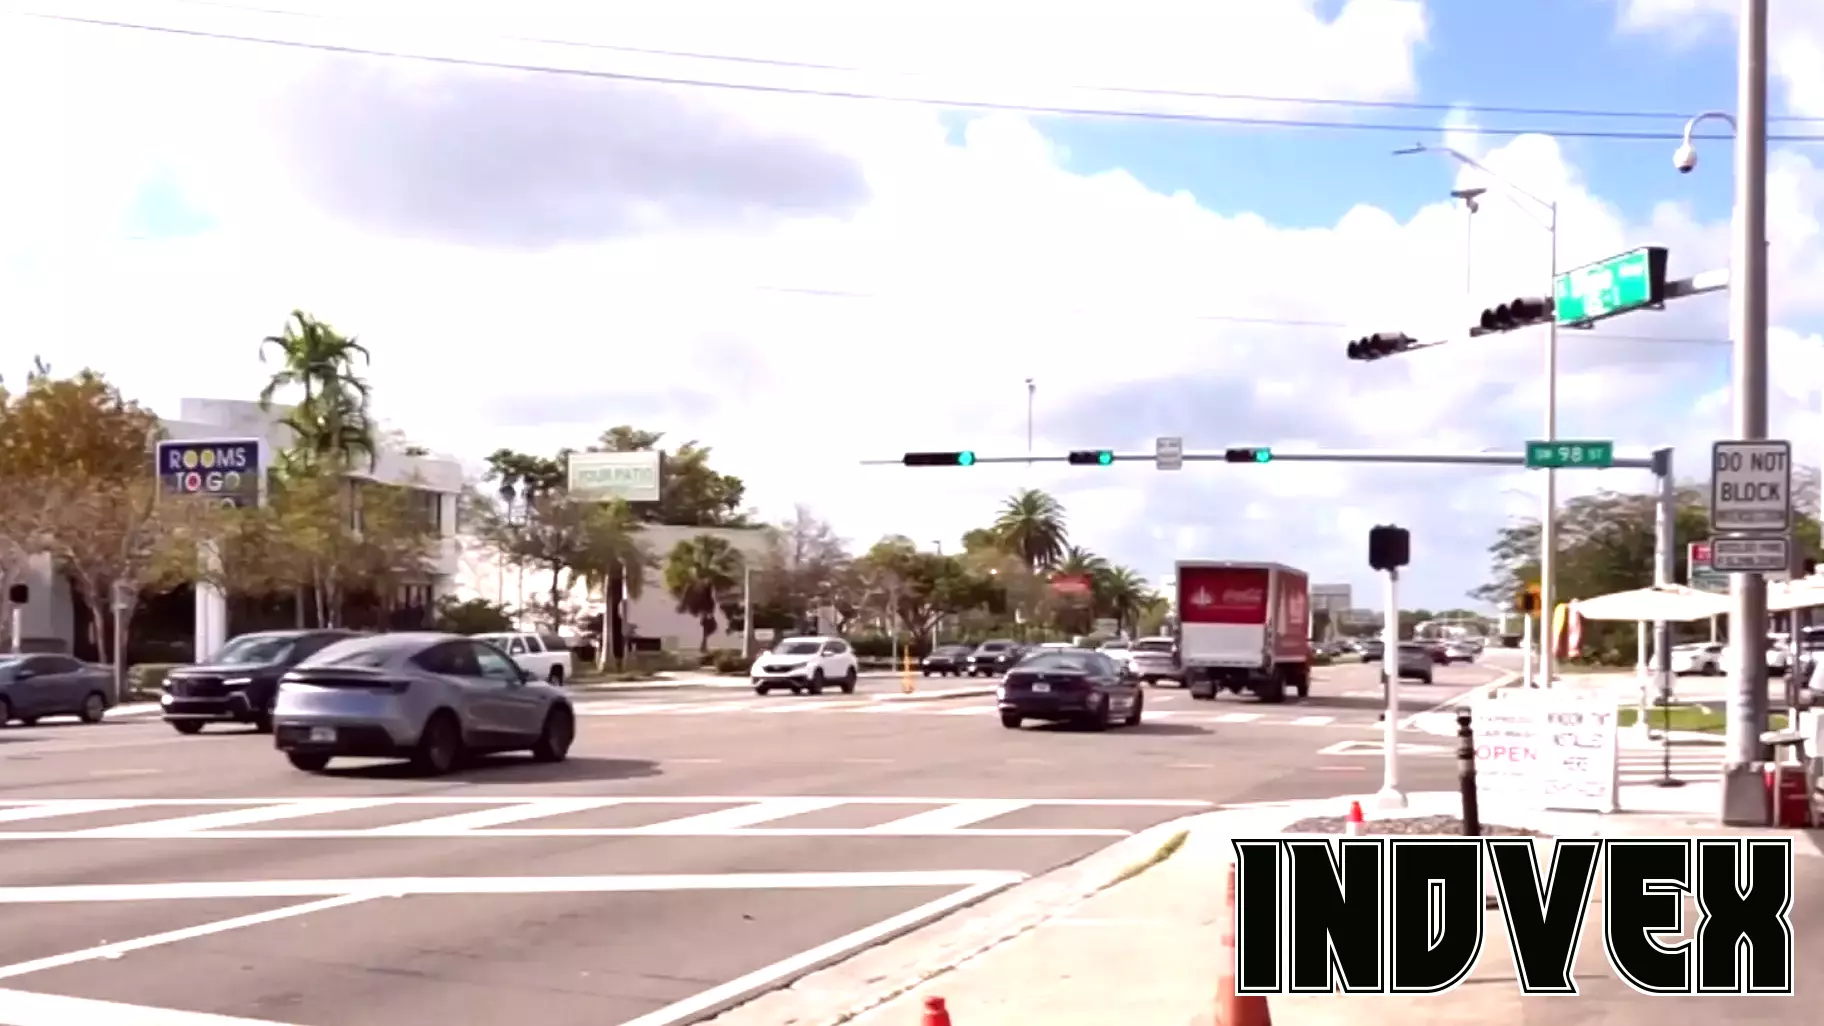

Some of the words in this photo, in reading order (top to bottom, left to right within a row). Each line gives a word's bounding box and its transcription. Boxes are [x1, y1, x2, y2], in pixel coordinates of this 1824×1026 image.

[169, 447, 246, 469] ROOMS
[1558, 446, 1582, 462] 98
[1718, 452, 1742, 471] DO
[1751, 452, 1786, 471] NOT
[175, 472, 201, 492] TO
[206, 471, 240, 492] GO
[1721, 483, 1780, 501] BLOCK
[1476, 746, 1537, 762] OPEN
